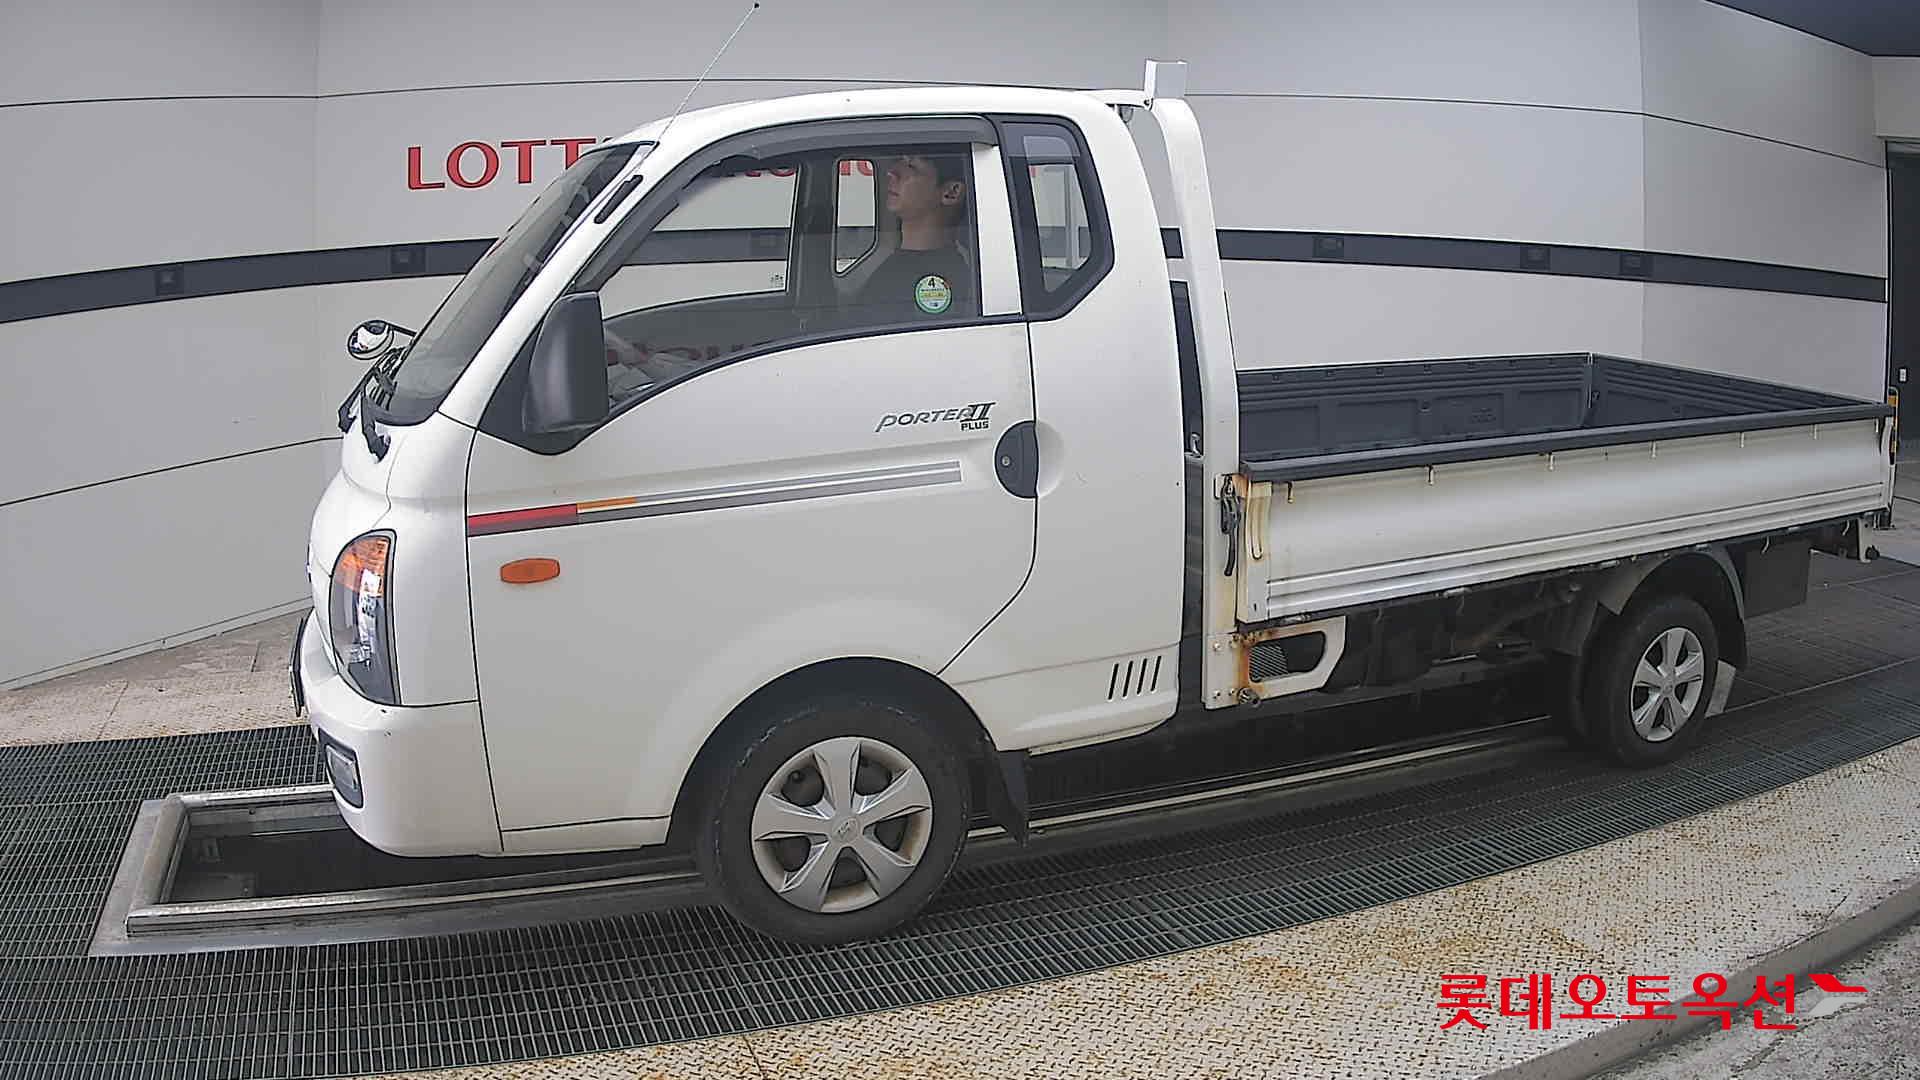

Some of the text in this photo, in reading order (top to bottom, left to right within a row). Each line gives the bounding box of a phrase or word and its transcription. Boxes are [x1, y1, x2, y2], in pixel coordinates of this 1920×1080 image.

[407, 136, 613, 191] LOTT
[927, 277, 936, 288] 4
[874, 407, 974, 433] PORTER
[960, 421, 990, 432] PLUS
